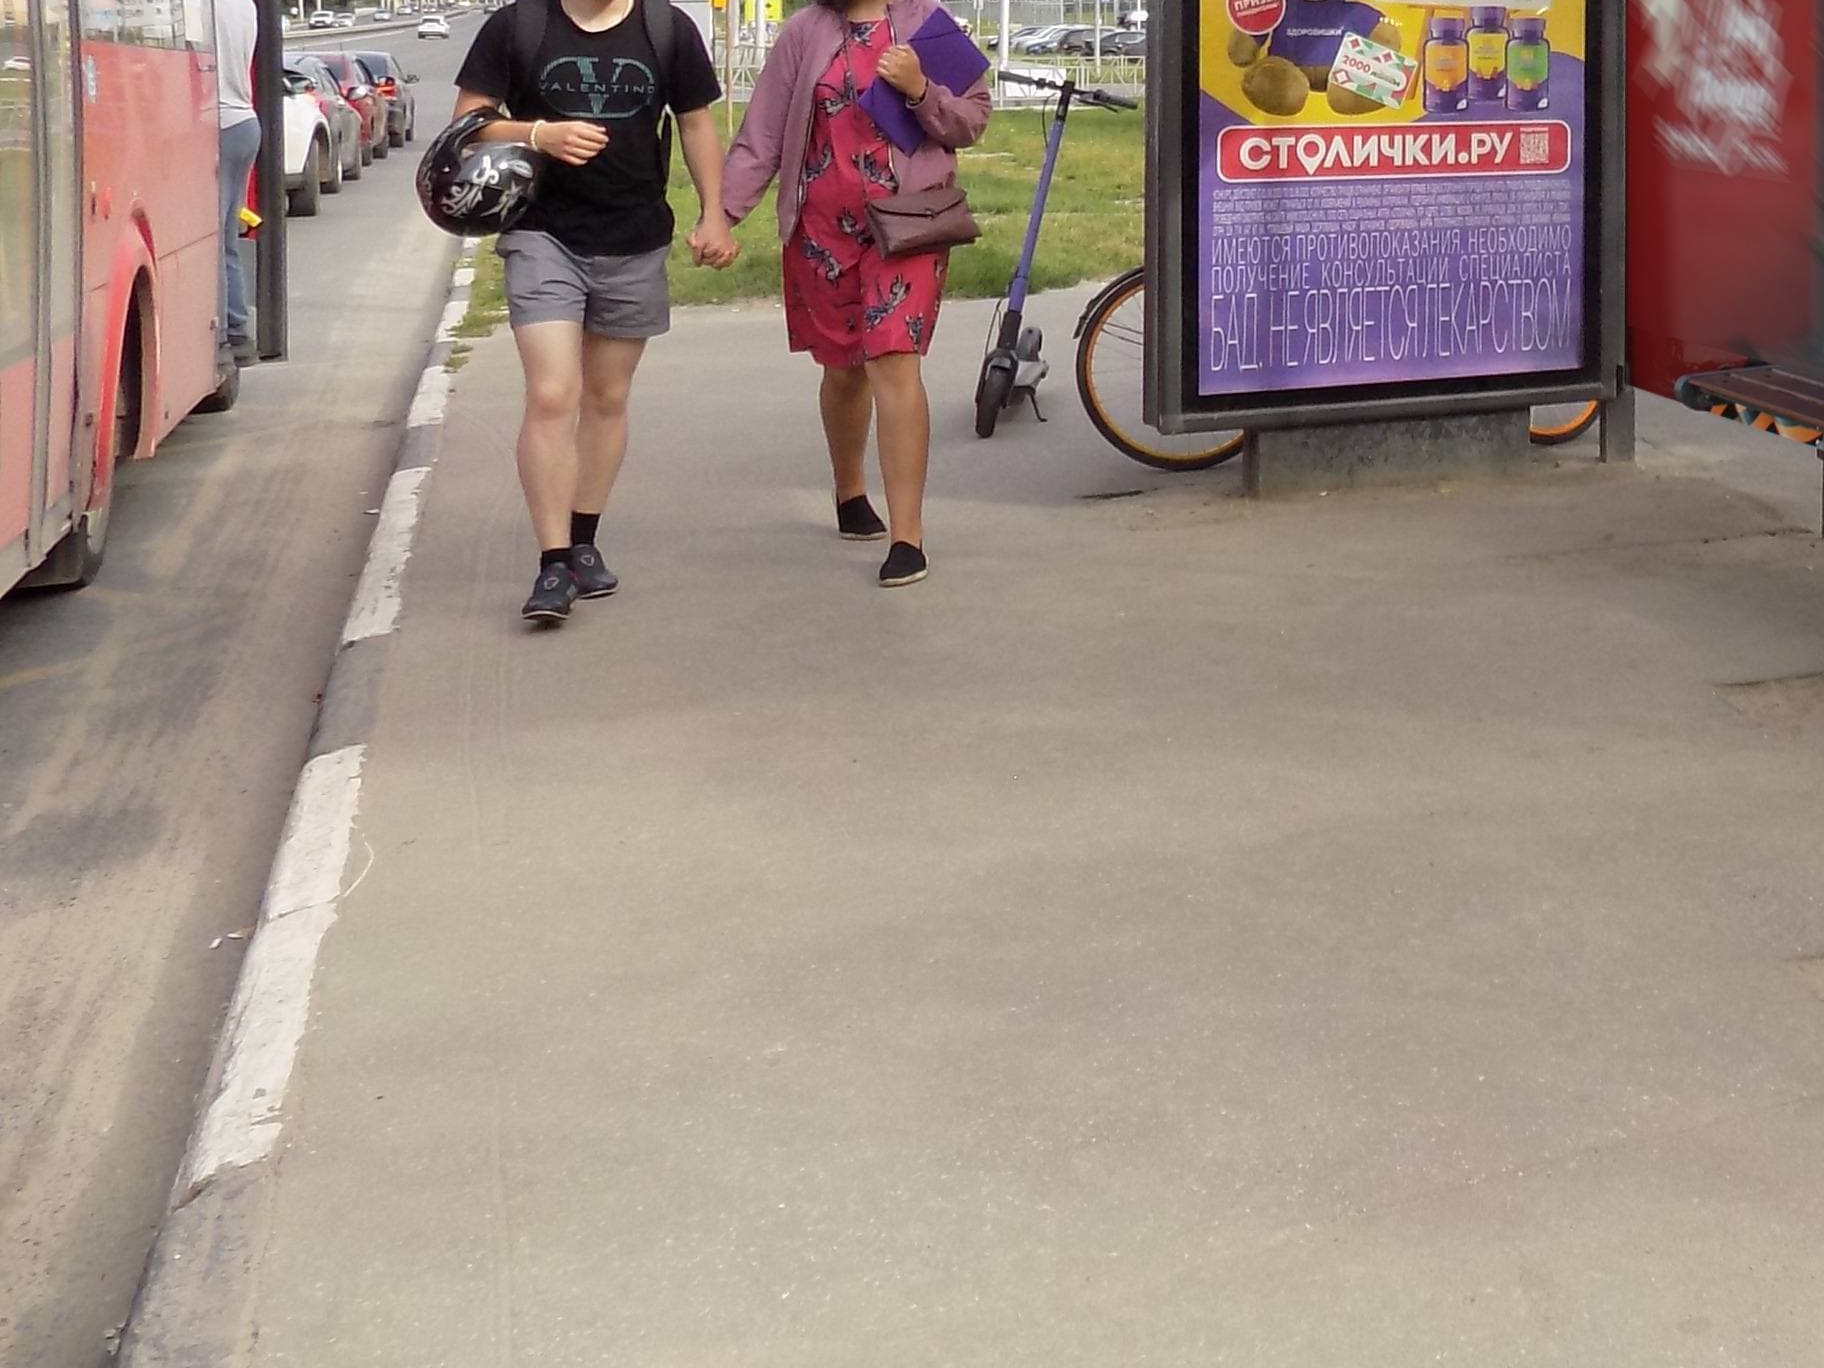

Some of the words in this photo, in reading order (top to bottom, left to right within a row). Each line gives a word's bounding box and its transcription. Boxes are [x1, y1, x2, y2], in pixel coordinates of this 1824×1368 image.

[1342, 54, 1372, 74] 2000
[539, 82, 656, 94] VALENTINO
[1239, 131, 1513, 176] СТОЛИЧКИ.РУ
[1211, 235, 1291, 265] ИМЕЮТСЯ
[1295, 228, 1465, 261] ПРОТИВОПОКАЗАНИЯ.
[1467, 223, 1572, 254] НЕОБХОДИМО
[1211, 261, 1311, 293] ПОЛУЧЕНИЕ
[1321, 256, 1449, 288] КОНСУЛЬТАЦИИ
[1458, 251, 1572, 281] СПЕЦИАЛИСТА
[1270, 290, 1299, 368] НЕ
[1303, 284, 1418, 366] ЯВЛЯЕТСЯ
[1421, 278, 1571, 359] ЛЕКАРСТВОМ
